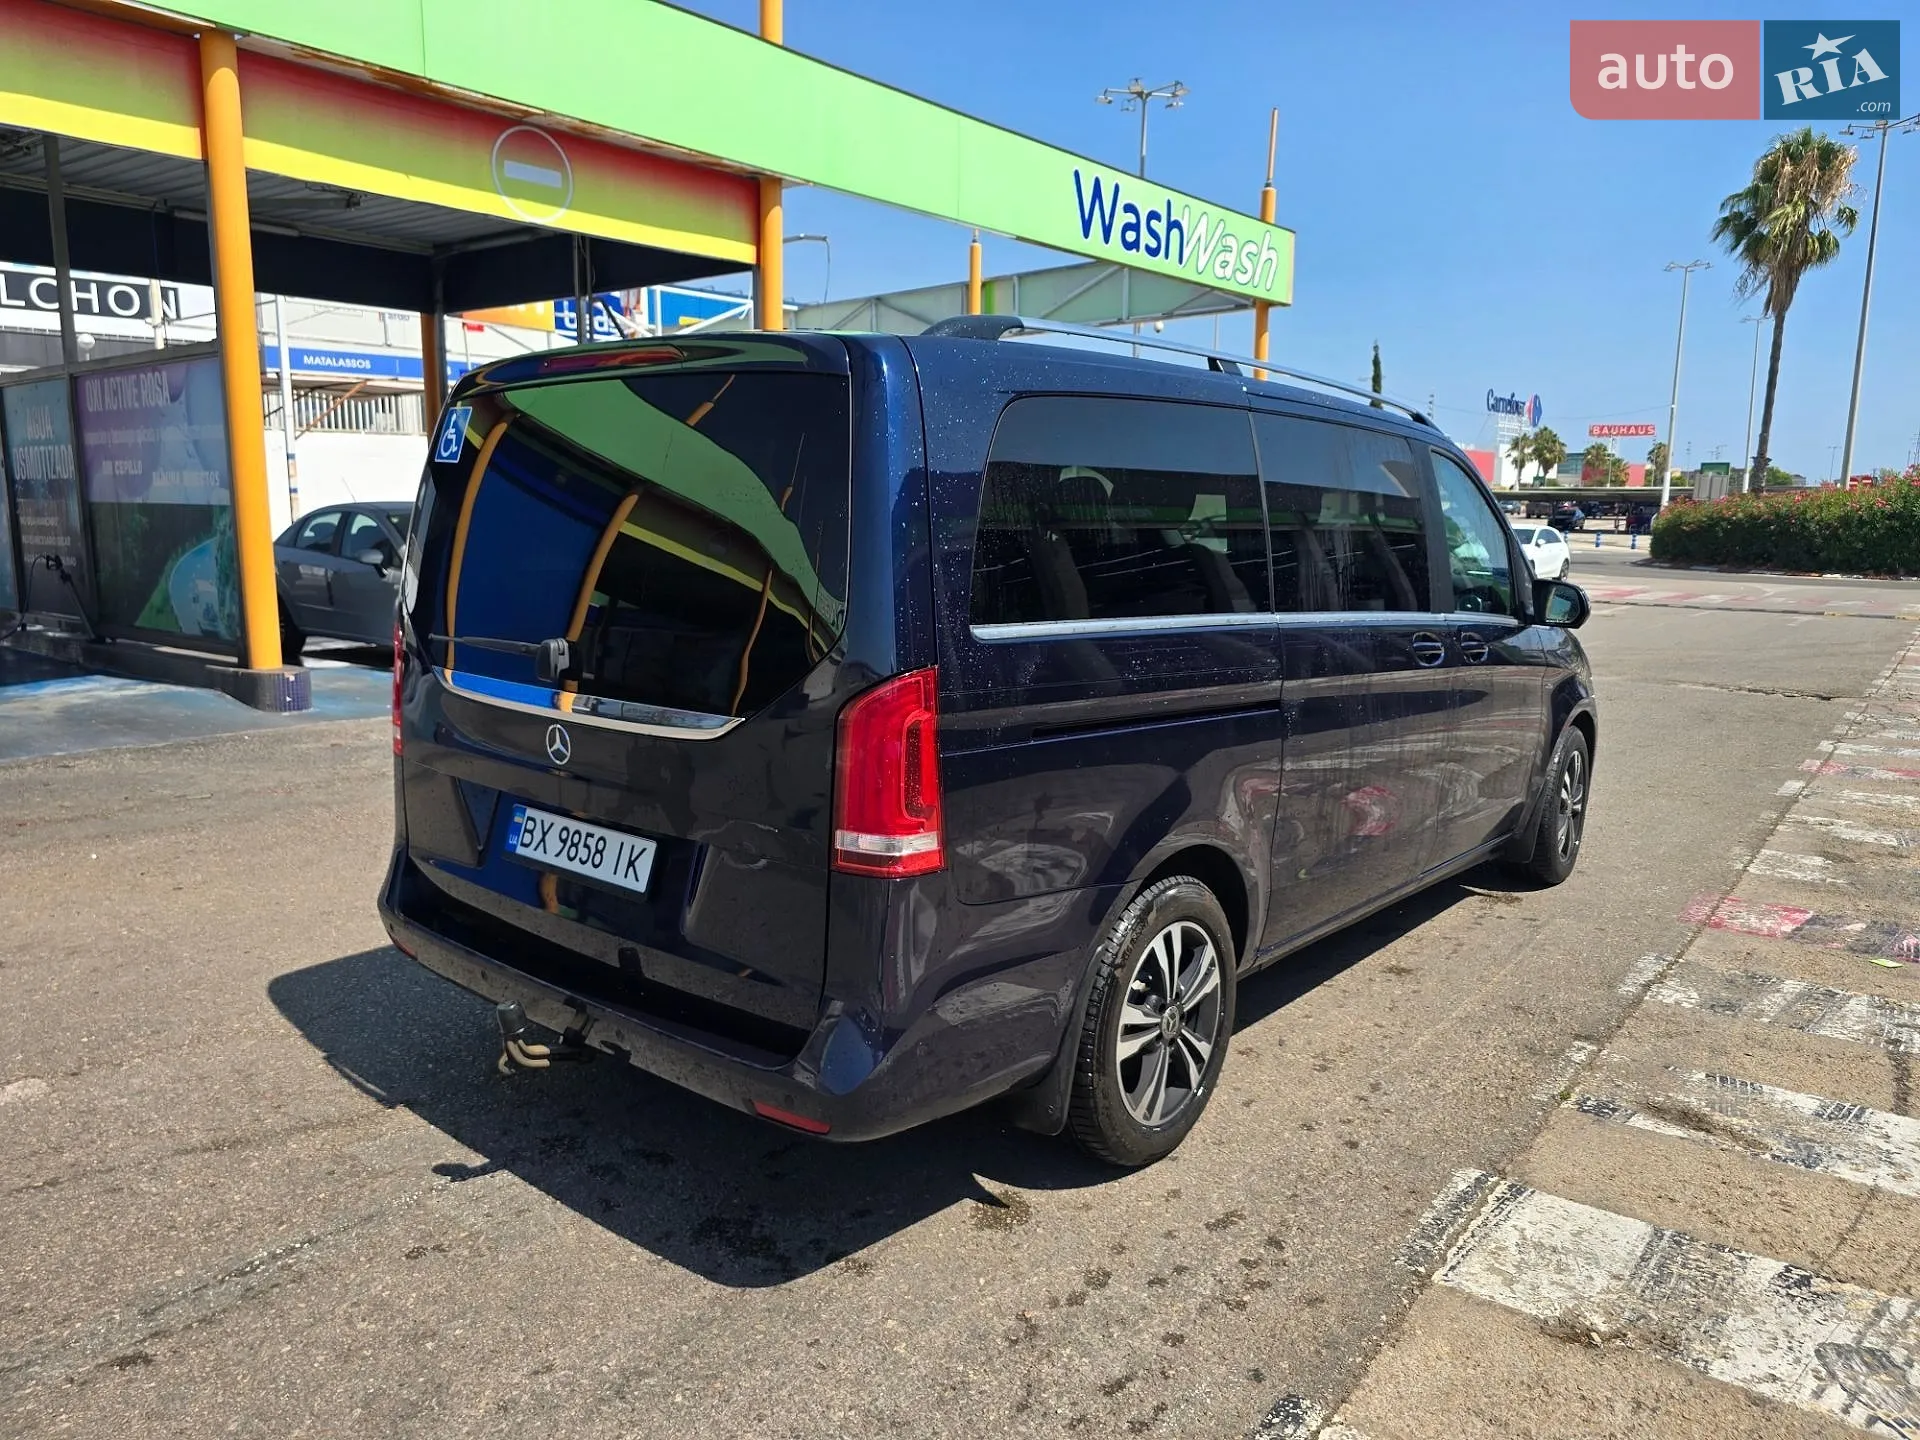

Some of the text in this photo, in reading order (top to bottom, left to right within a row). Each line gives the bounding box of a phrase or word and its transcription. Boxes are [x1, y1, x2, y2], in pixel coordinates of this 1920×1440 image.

[303, 354, 372, 370] MATALASSOS
[85, 371, 171, 412] OXI ACTIVE ROSA
[1592, 425, 1655, 435] BAUHAUS
[14, 444, 76, 481] OSMOTIZADA
[520, 816, 648, 883] BX 9858 IK
